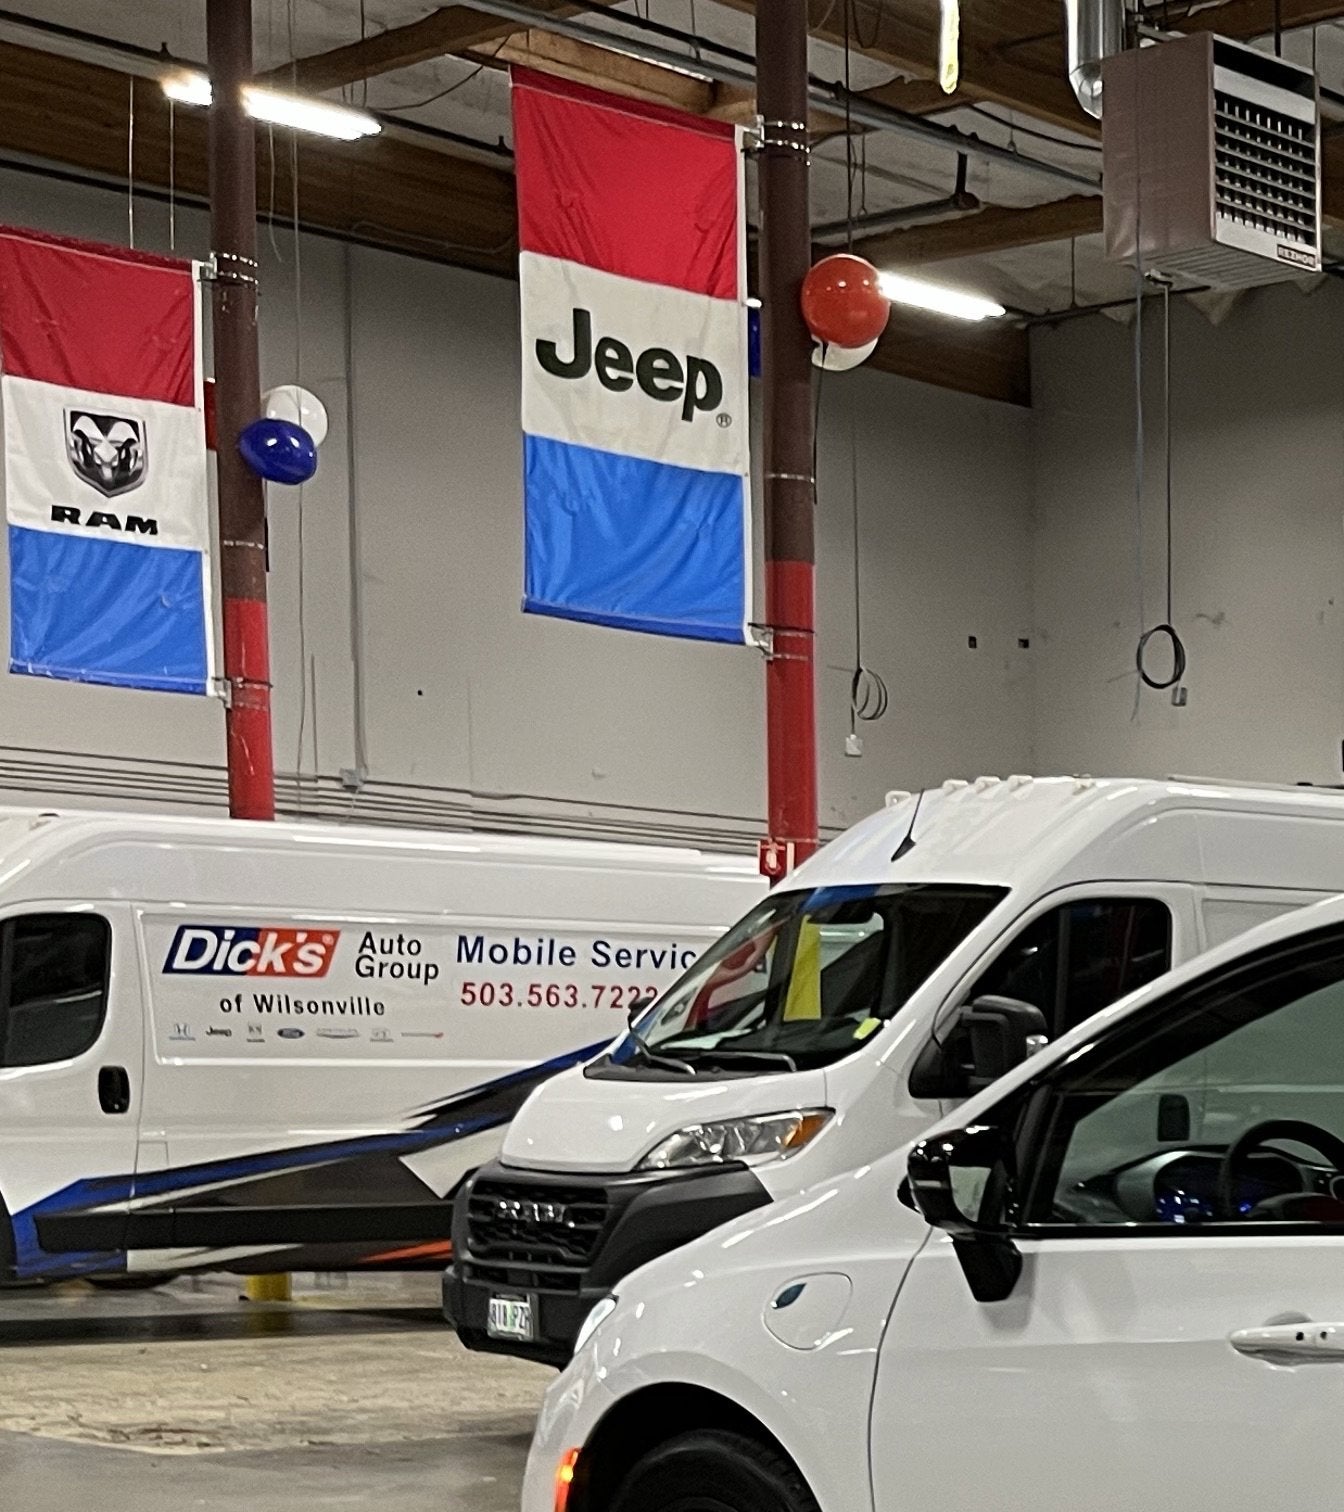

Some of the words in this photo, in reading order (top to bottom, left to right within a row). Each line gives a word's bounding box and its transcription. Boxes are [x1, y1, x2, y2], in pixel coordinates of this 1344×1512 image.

[535, 307, 723, 422] Jeep
[51, 505, 158, 535] RAM
[358, 931, 421, 956] Auto
[457, 935, 577, 966] Mobile
[355, 954, 438, 985] Group
[220, 994, 242, 1013] of
[253, 993, 385, 1016] Wilsonville
